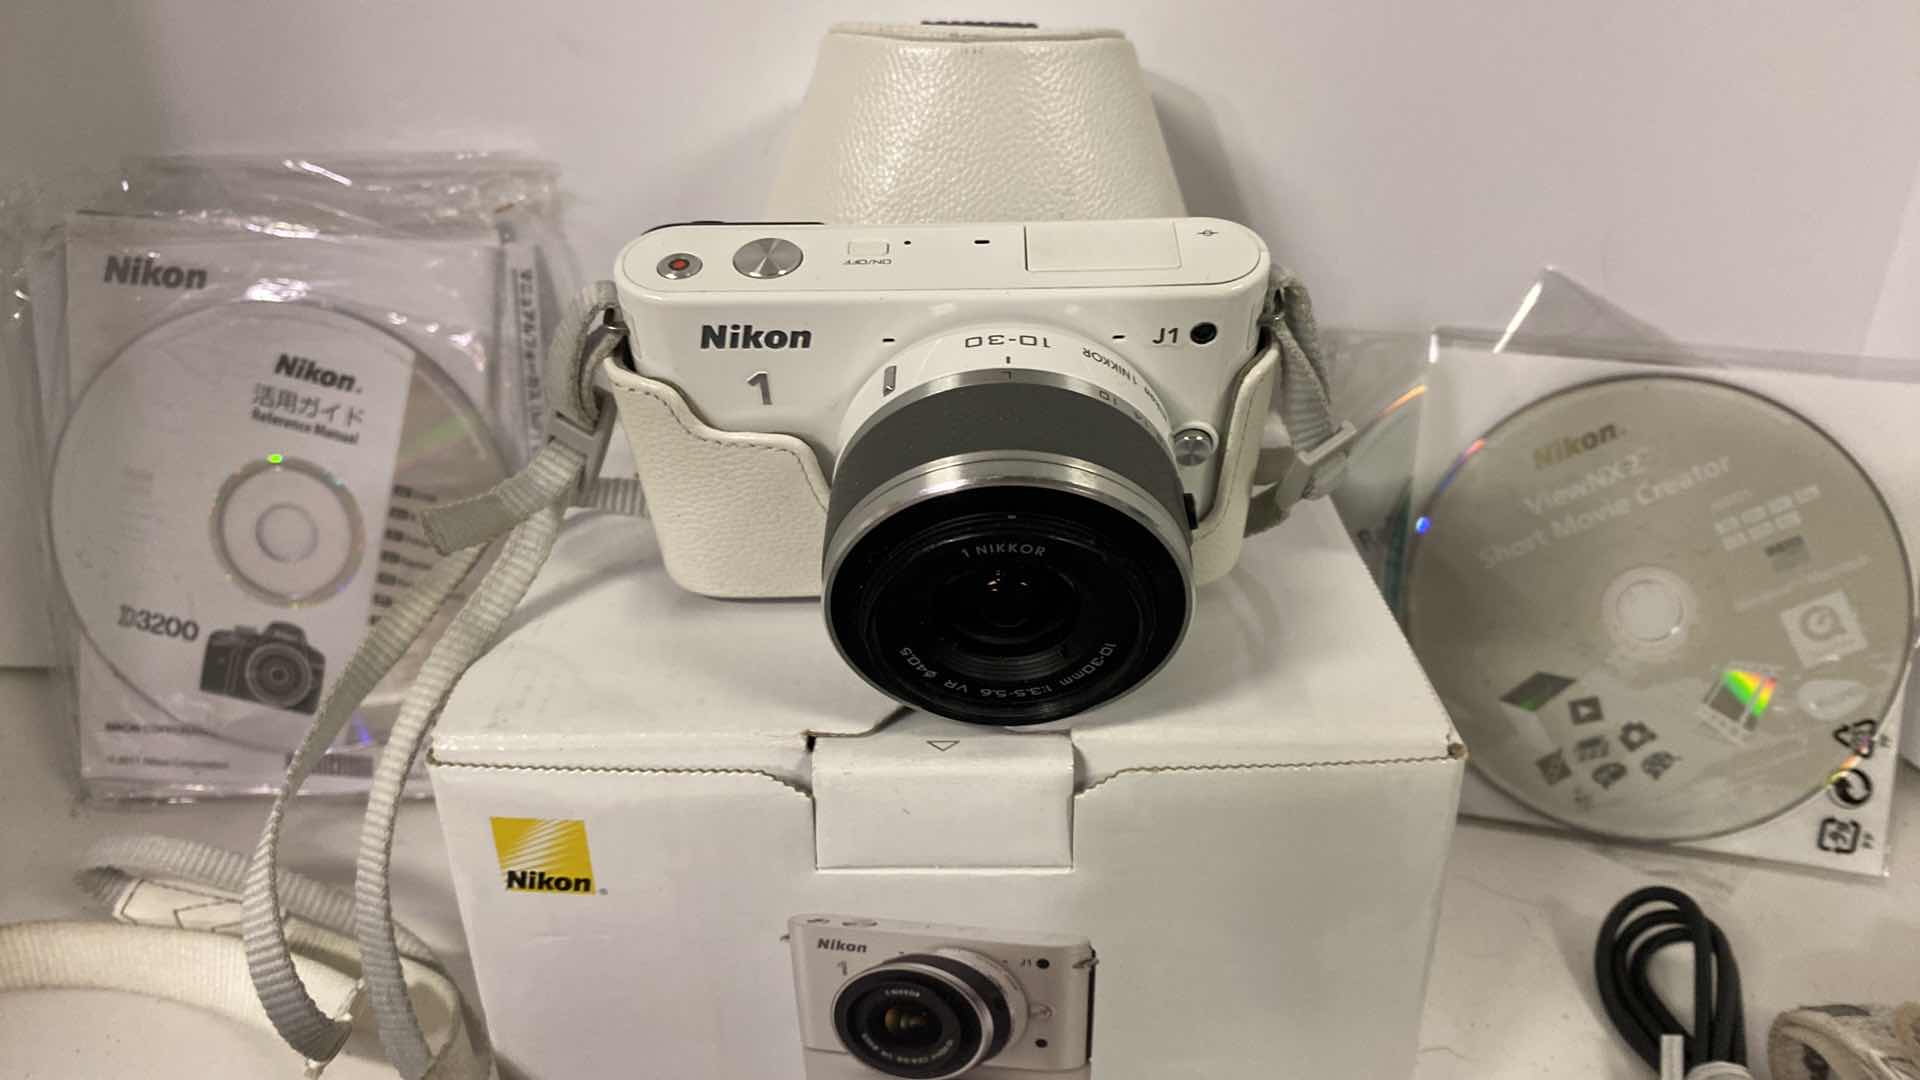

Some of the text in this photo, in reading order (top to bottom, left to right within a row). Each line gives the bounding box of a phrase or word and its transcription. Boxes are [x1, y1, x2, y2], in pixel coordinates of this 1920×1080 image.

[103, 256, 208, 289] Nikon
[700, 323, 812, 350] Nikon
[964, 335, 1051, 349] 10-30
[1152, 327, 1178, 344] J1
[1082, 347, 1131, 381] NIKKOR
[746, 371, 772, 405] 1
[1636, 456, 1730, 505] Creator
[976, 543, 1046, 557] NIKKOR
[118, 603, 199, 642] D3200
[943, 679, 968, 694] VR
[507, 870, 592, 892] Nikon
[817, 937, 868, 953] Nikon
